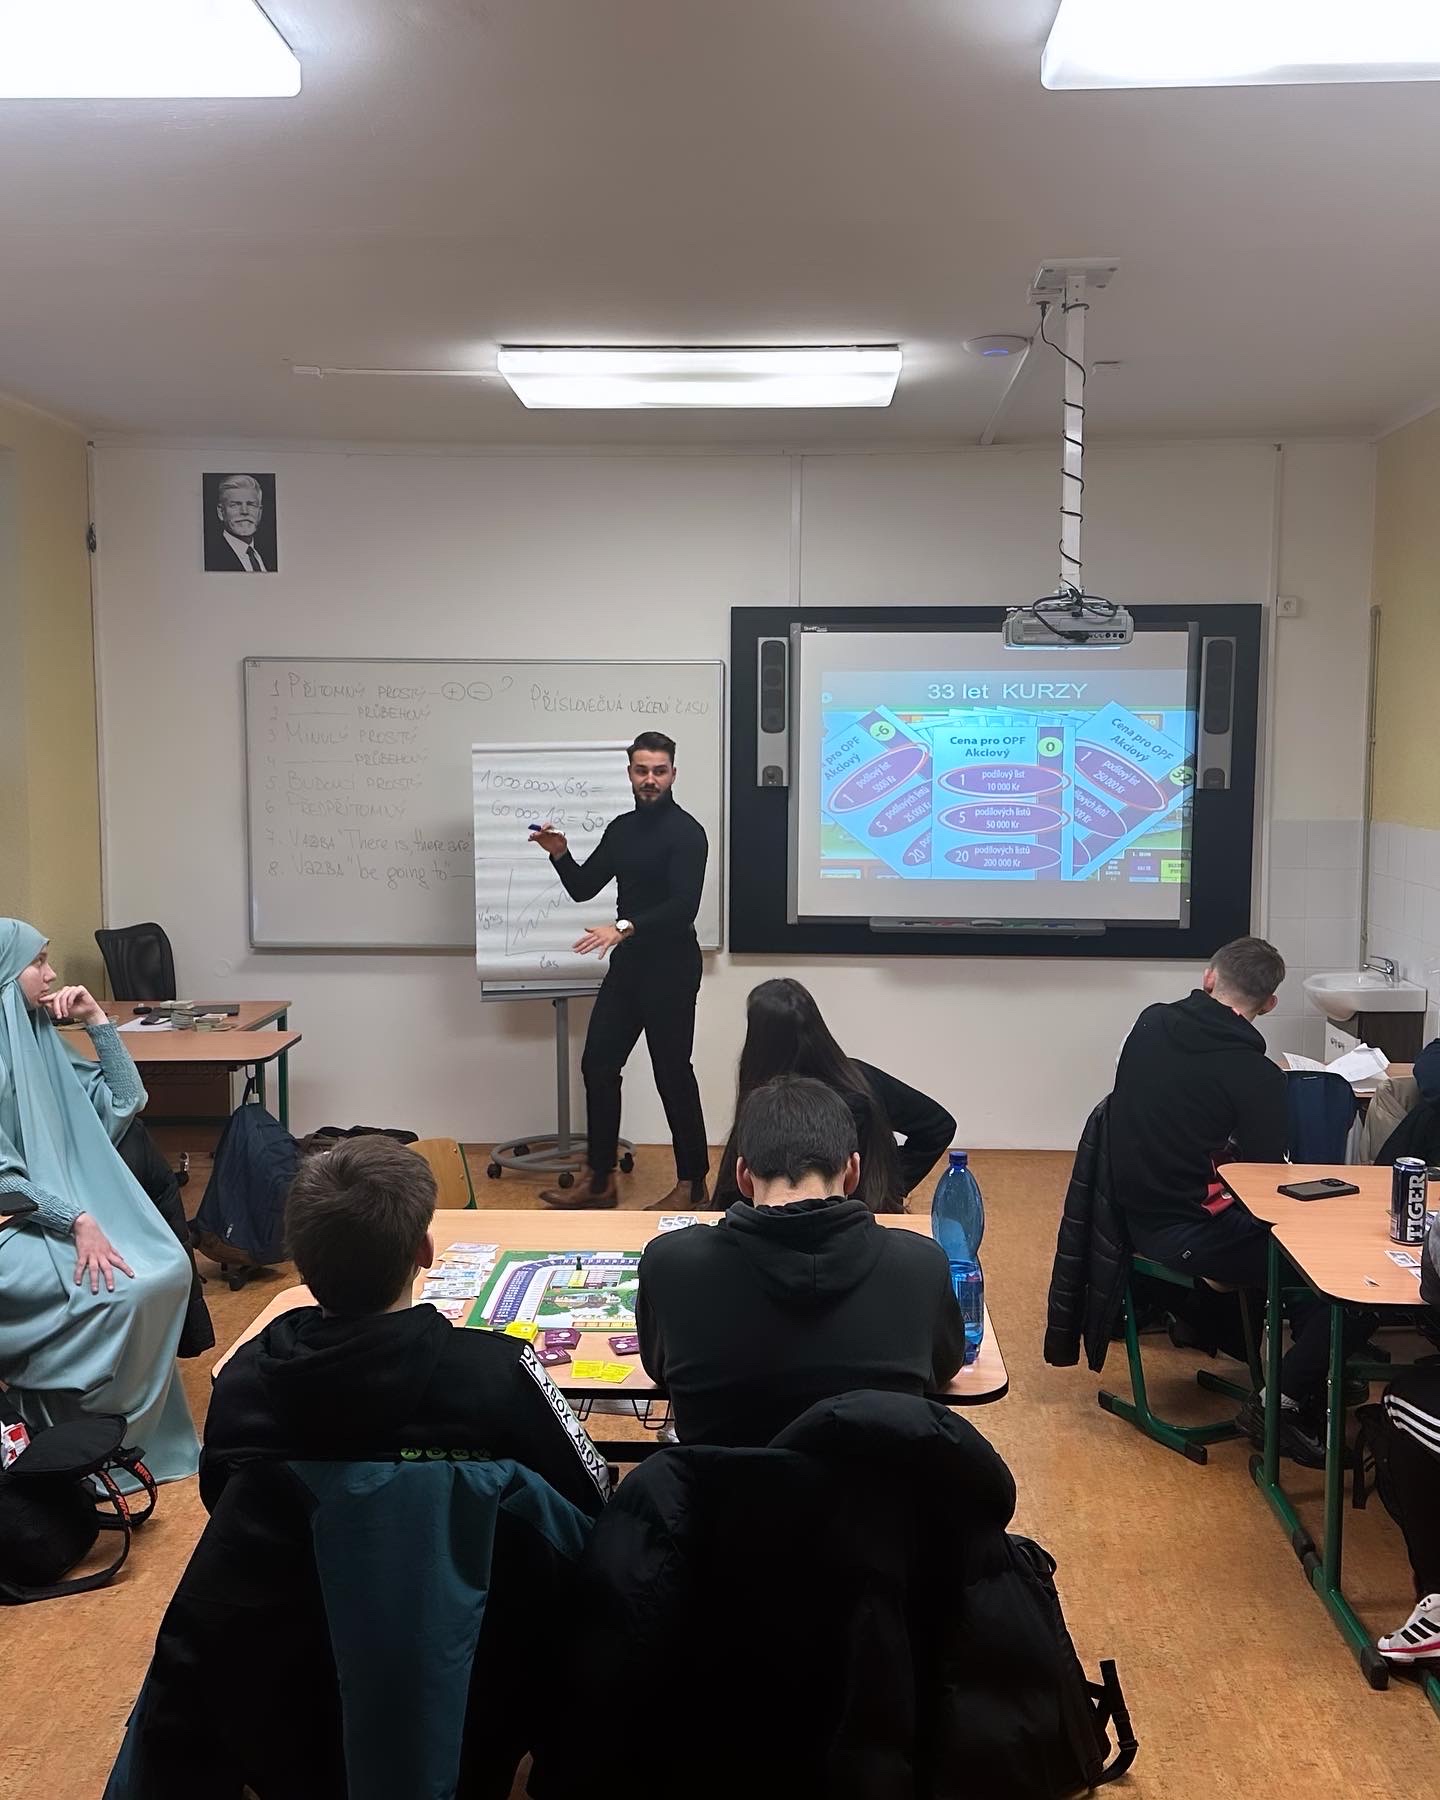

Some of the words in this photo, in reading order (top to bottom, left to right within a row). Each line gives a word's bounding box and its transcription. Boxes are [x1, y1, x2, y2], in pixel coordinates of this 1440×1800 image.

[928, 684, 955, 699] 33
[962, 684, 989, 699] let
[1002, 684, 1088, 699] KURZY
[825, 750, 842, 765] pro
[841, 736, 860, 752] OPF
[950, 736, 978, 745] Cena
[981, 738, 1000, 747] pro
[1003, 736, 1026, 745] OPF
[1111, 718, 1135, 736] Cena
[1134, 731, 1152, 748] pro
[1151, 742, 1174, 761] OPF
[960, 774, 966, 786] 1
[959, 811, 967, 824] 5
[955, 851, 969, 863] 20
[387, 867, 430, 890] going
[1407, 1172, 1426, 1241] TIGER
[542, 1377, 573, 1423] XBOX
[574, 1427, 604, 1477] XBOX
